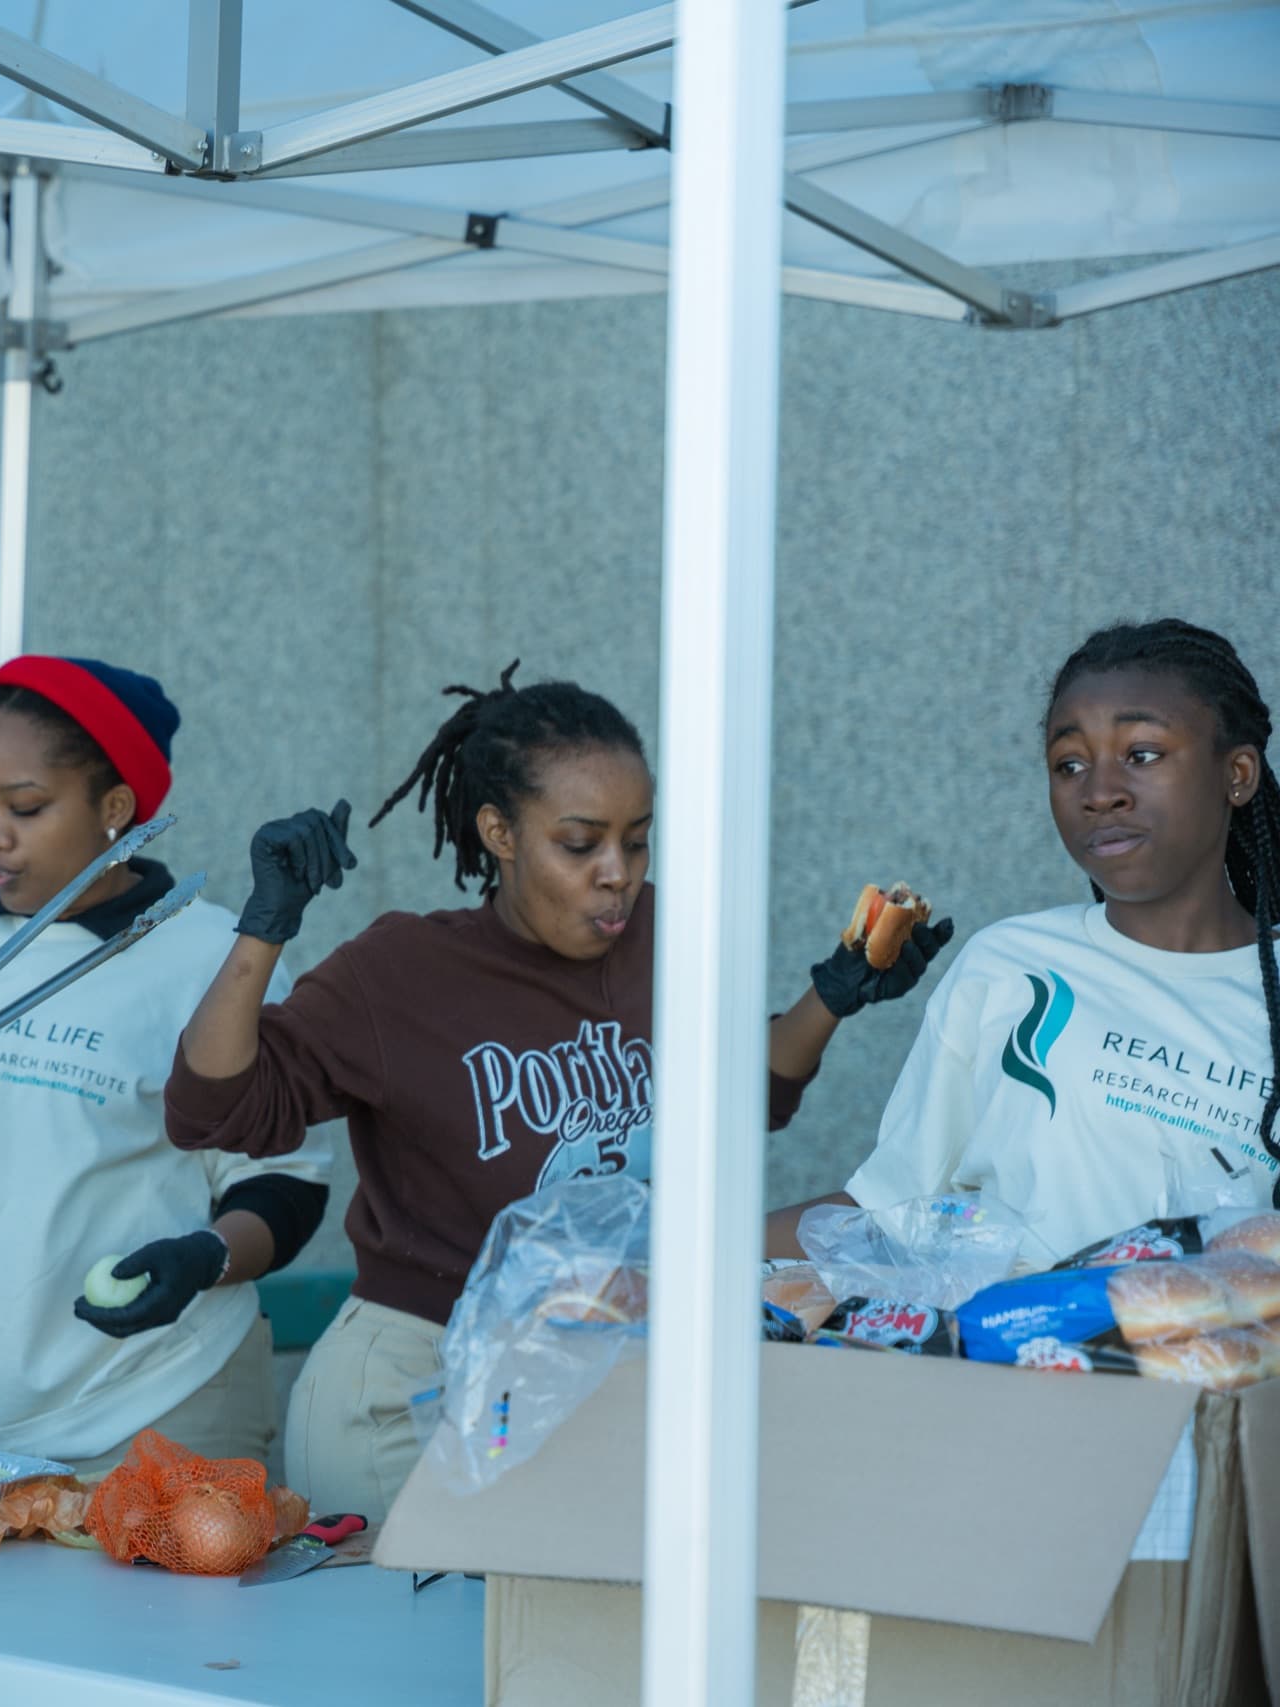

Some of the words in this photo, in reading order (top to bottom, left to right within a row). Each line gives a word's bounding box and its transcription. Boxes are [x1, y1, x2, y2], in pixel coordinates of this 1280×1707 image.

[47, 1023, 104, 1051] LIFE
[44, 1059, 128, 1095] INSTITUTE
[1102, 1032, 1191, 1075] REAL
[1205, 1061, 1275, 1101] LIFE
[1092, 1069, 1200, 1112] RESEARCH
